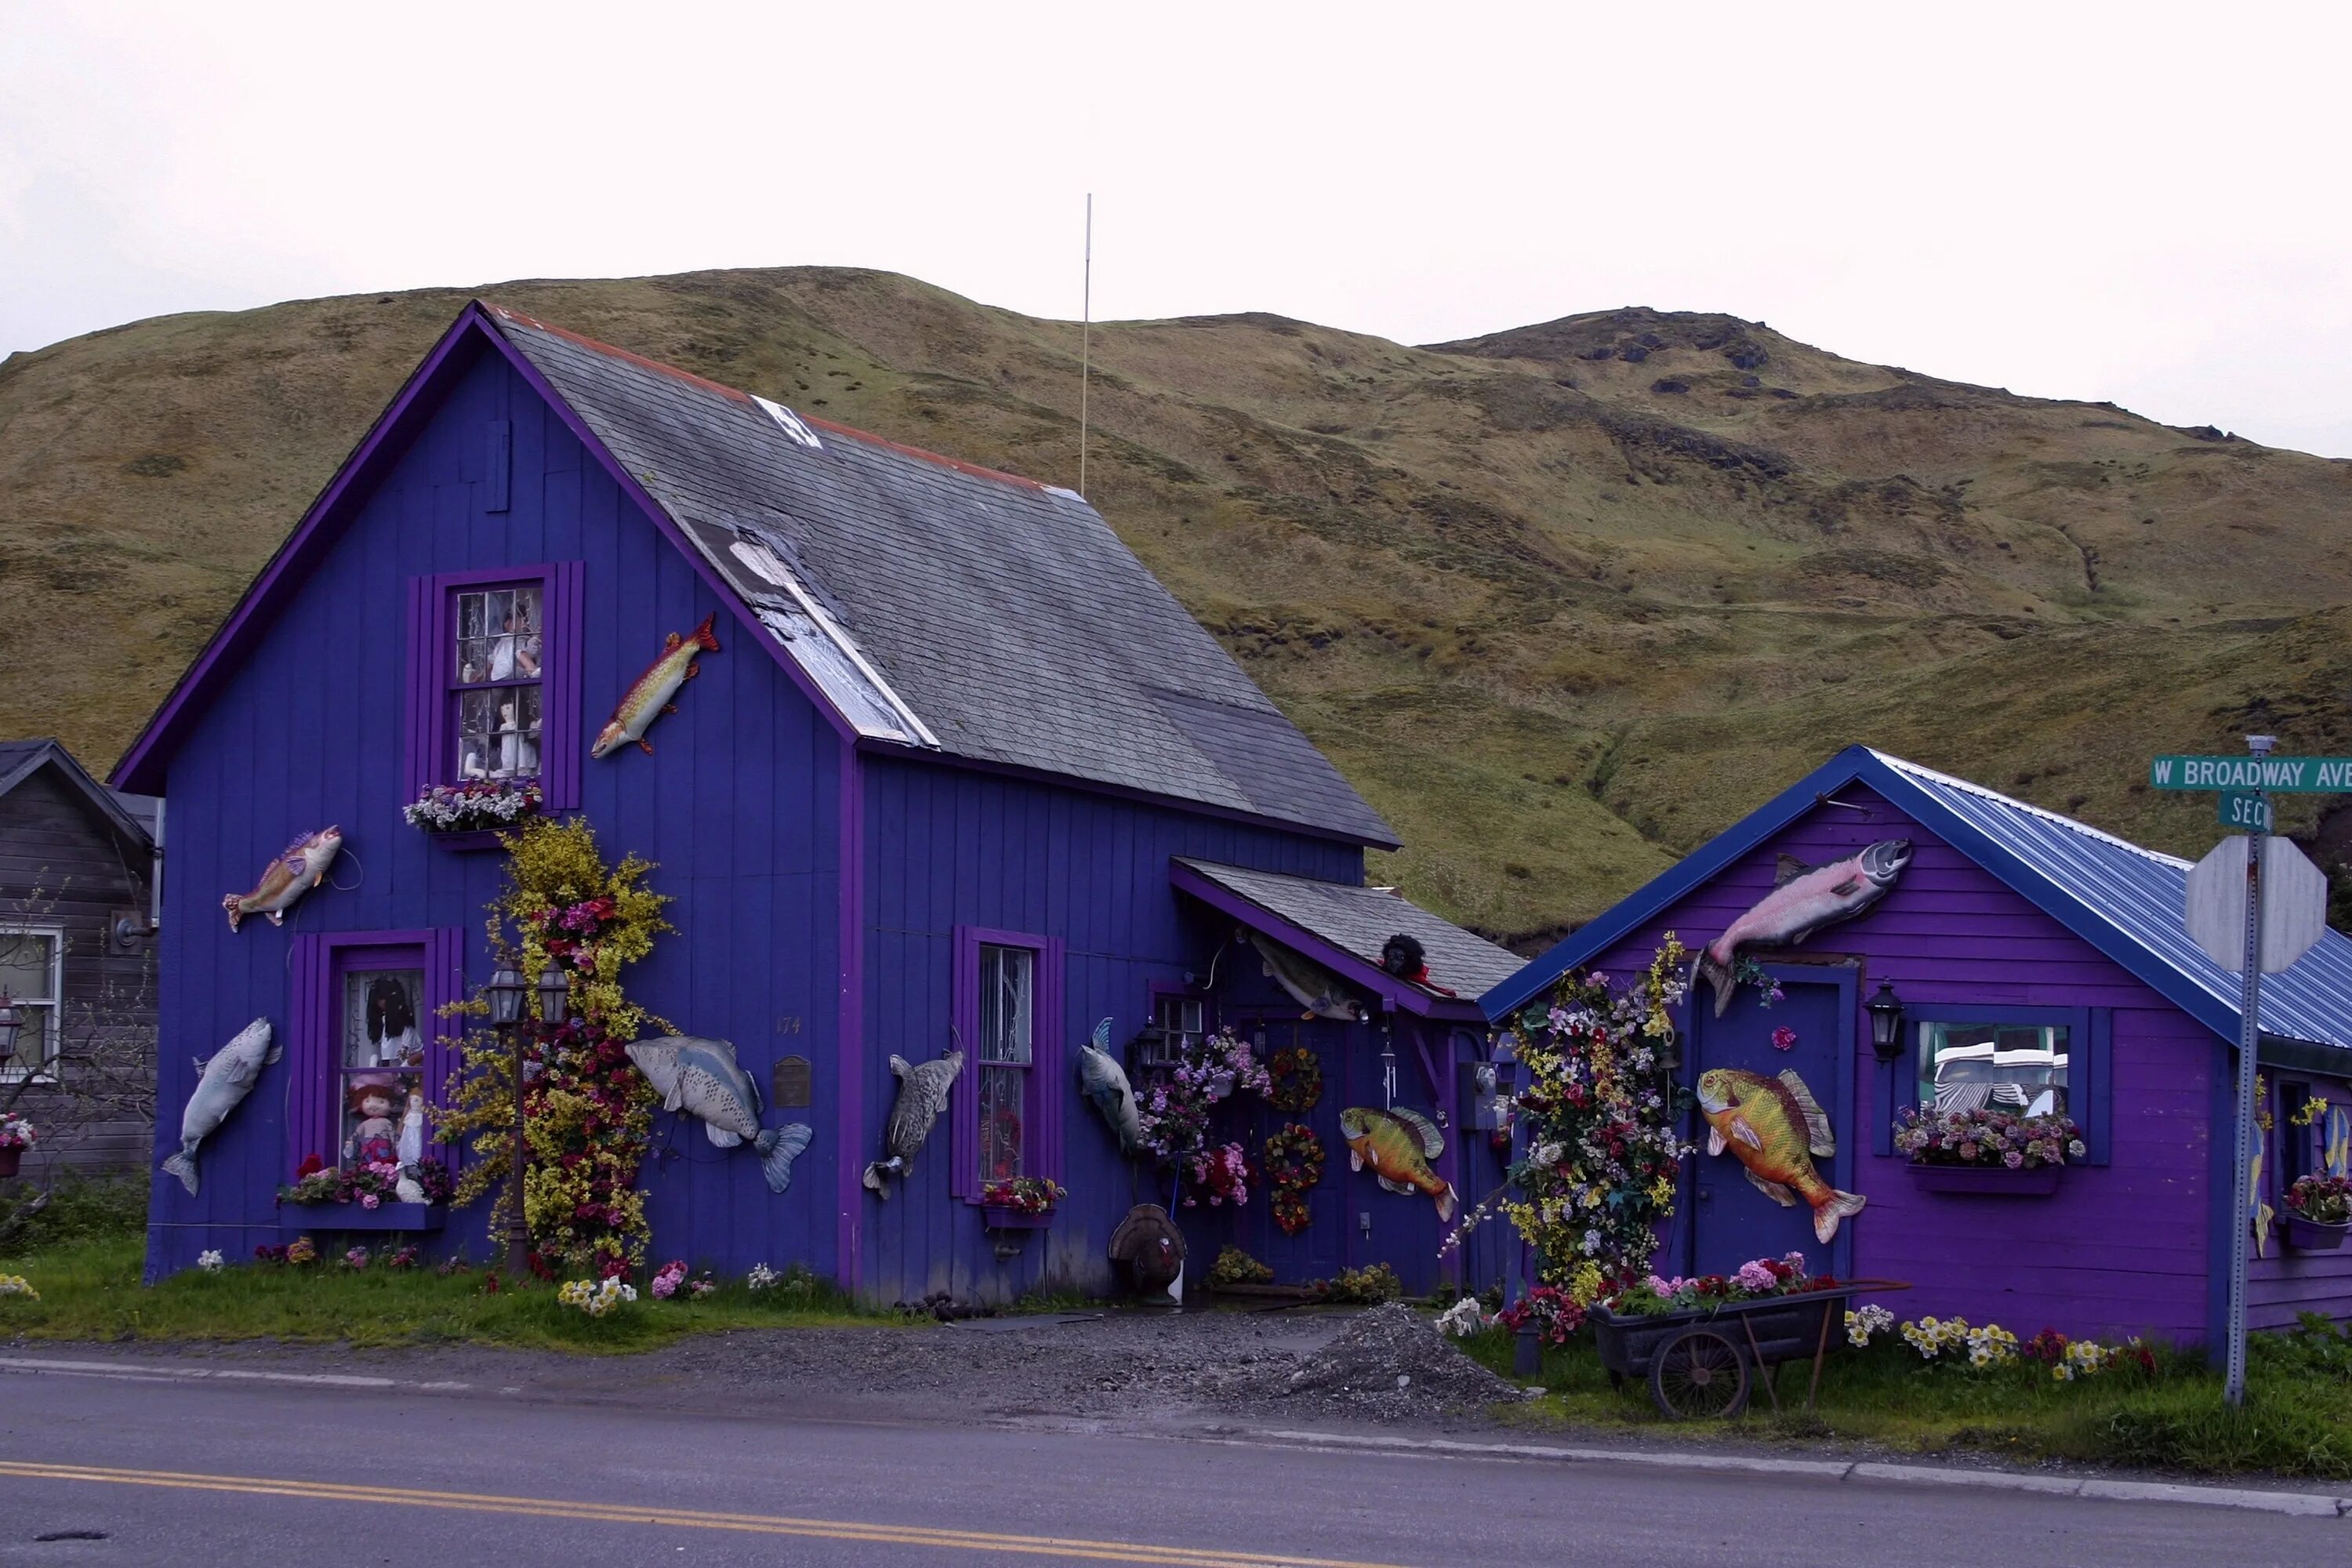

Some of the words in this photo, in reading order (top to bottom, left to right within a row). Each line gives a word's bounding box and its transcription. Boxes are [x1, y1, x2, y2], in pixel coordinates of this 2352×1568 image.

[2154, 760, 2172, 784] W
[2184, 760, 2305, 786] BROADWAY
[2316, 762, 2352, 787] AVE
